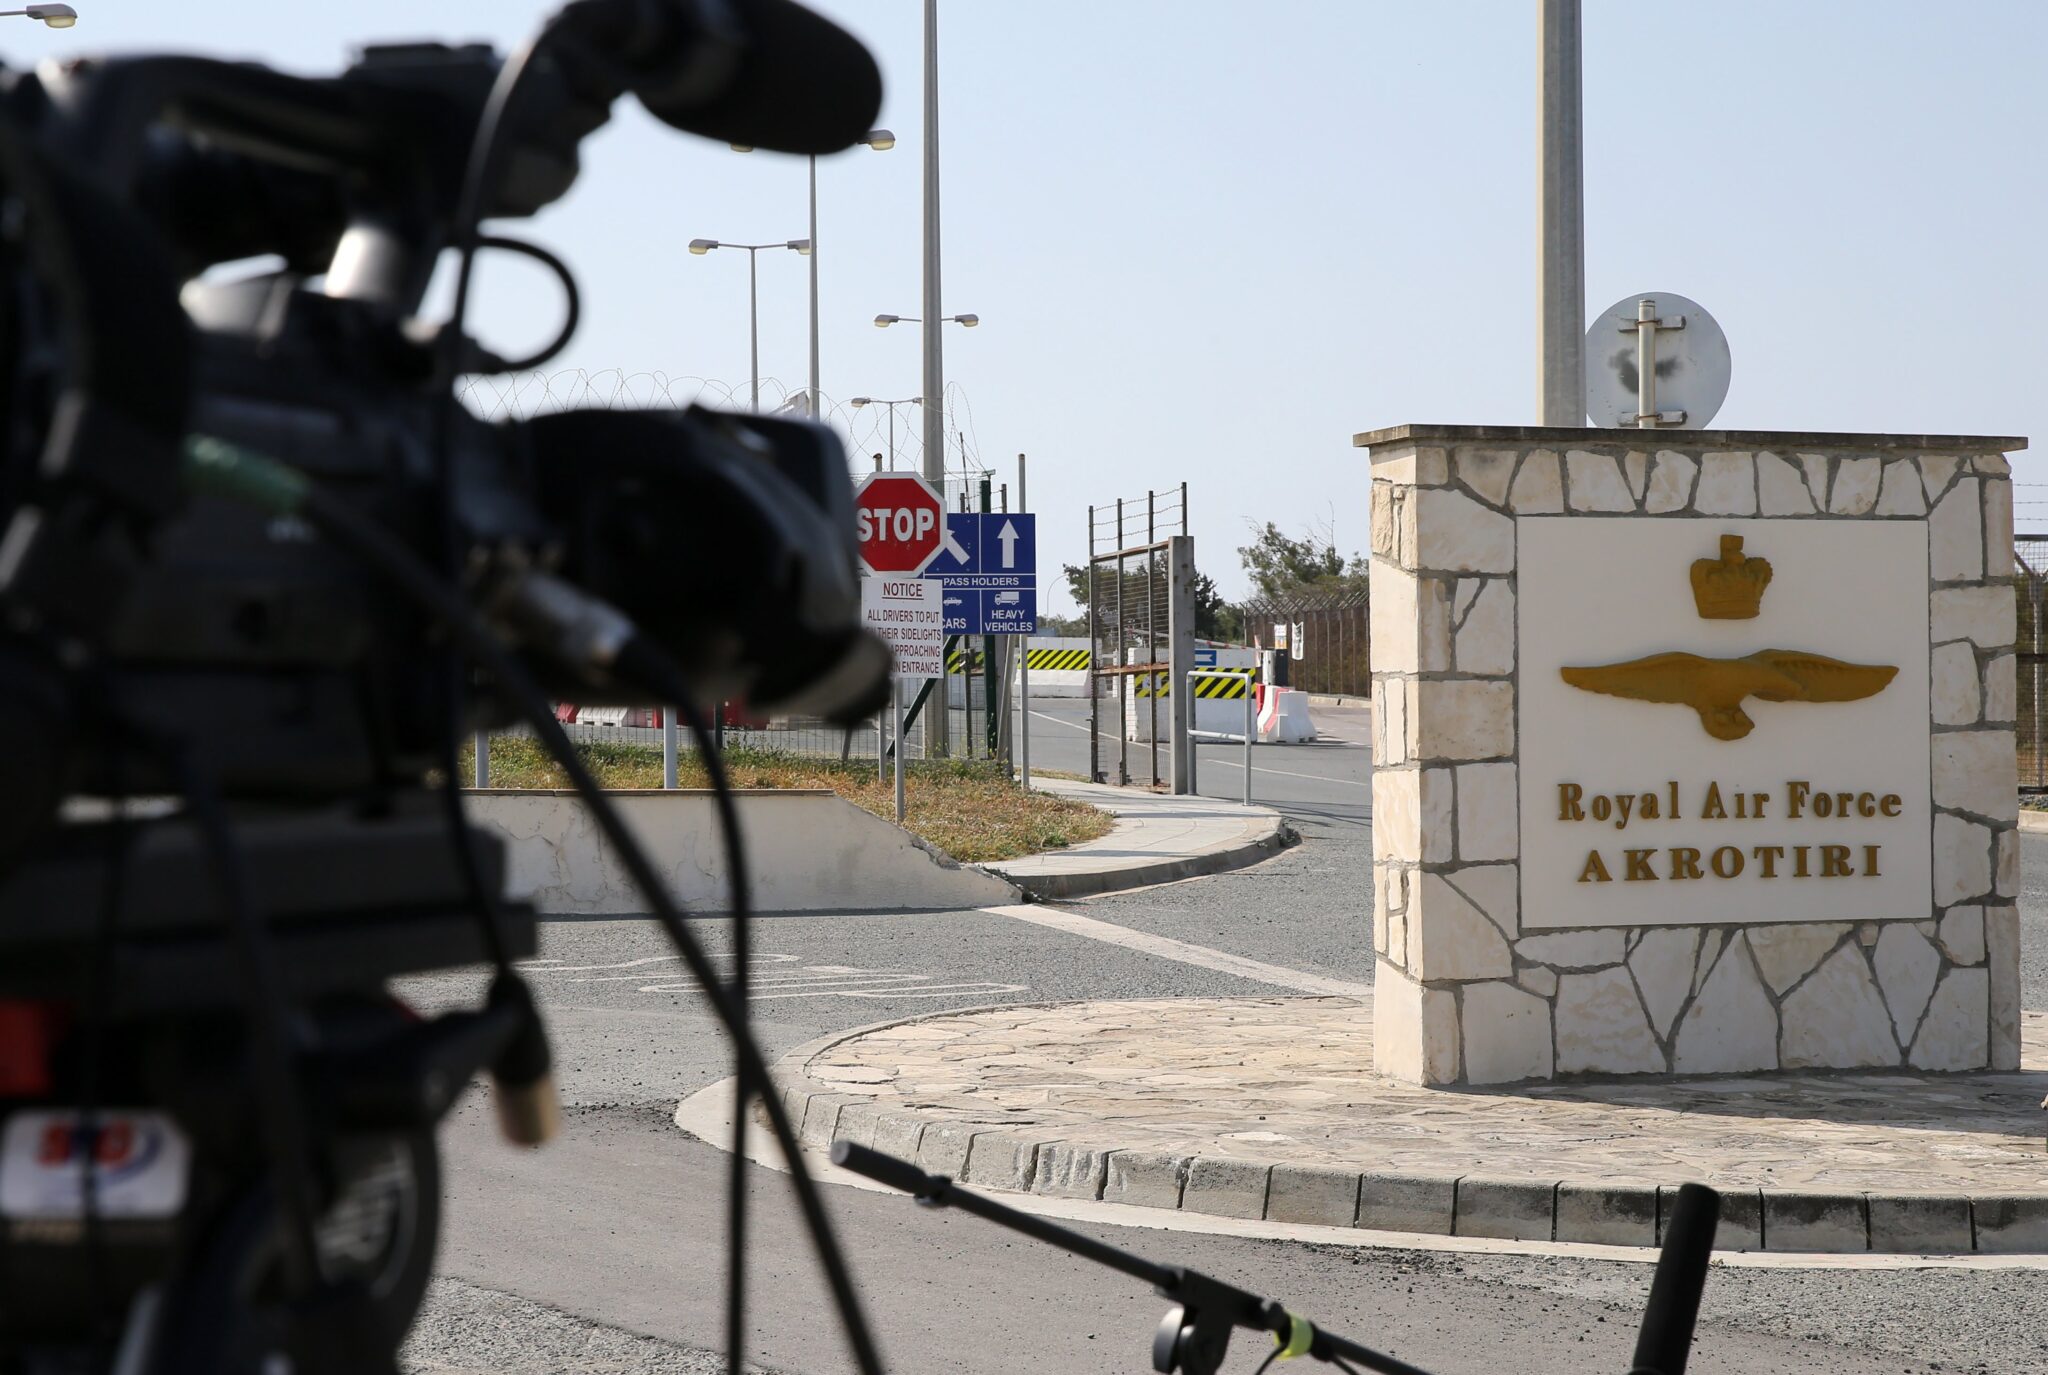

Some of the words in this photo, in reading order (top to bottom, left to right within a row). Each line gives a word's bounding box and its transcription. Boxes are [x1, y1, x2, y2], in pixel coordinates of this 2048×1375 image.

[857, 507, 934, 542] STOP
[944, 577, 969, 586] PASS
[971, 577, 1019, 586] HOLDERS
[883, 582, 923, 597] NOTICE
[867, 609, 881, 622] ALL
[883, 609, 913, 623] DRIVERS
[915, 611, 925, 623] TO
[926, 611, 939, 623] PUT
[991, 610, 1025, 620] HEAVY
[878, 627, 899, 640] THEIR
[901, 628, 942, 641] SIDELIGHTS
[984, 622, 1033, 632] VEHICLES
[902, 661, 940, 674] ENTRANCE
[1557, 781, 1682, 830] Royal
[1701, 780, 1770, 820] Air
[1786, 780, 1903, 820] Force
[1577, 844, 1882, 883] AKROTIRI
